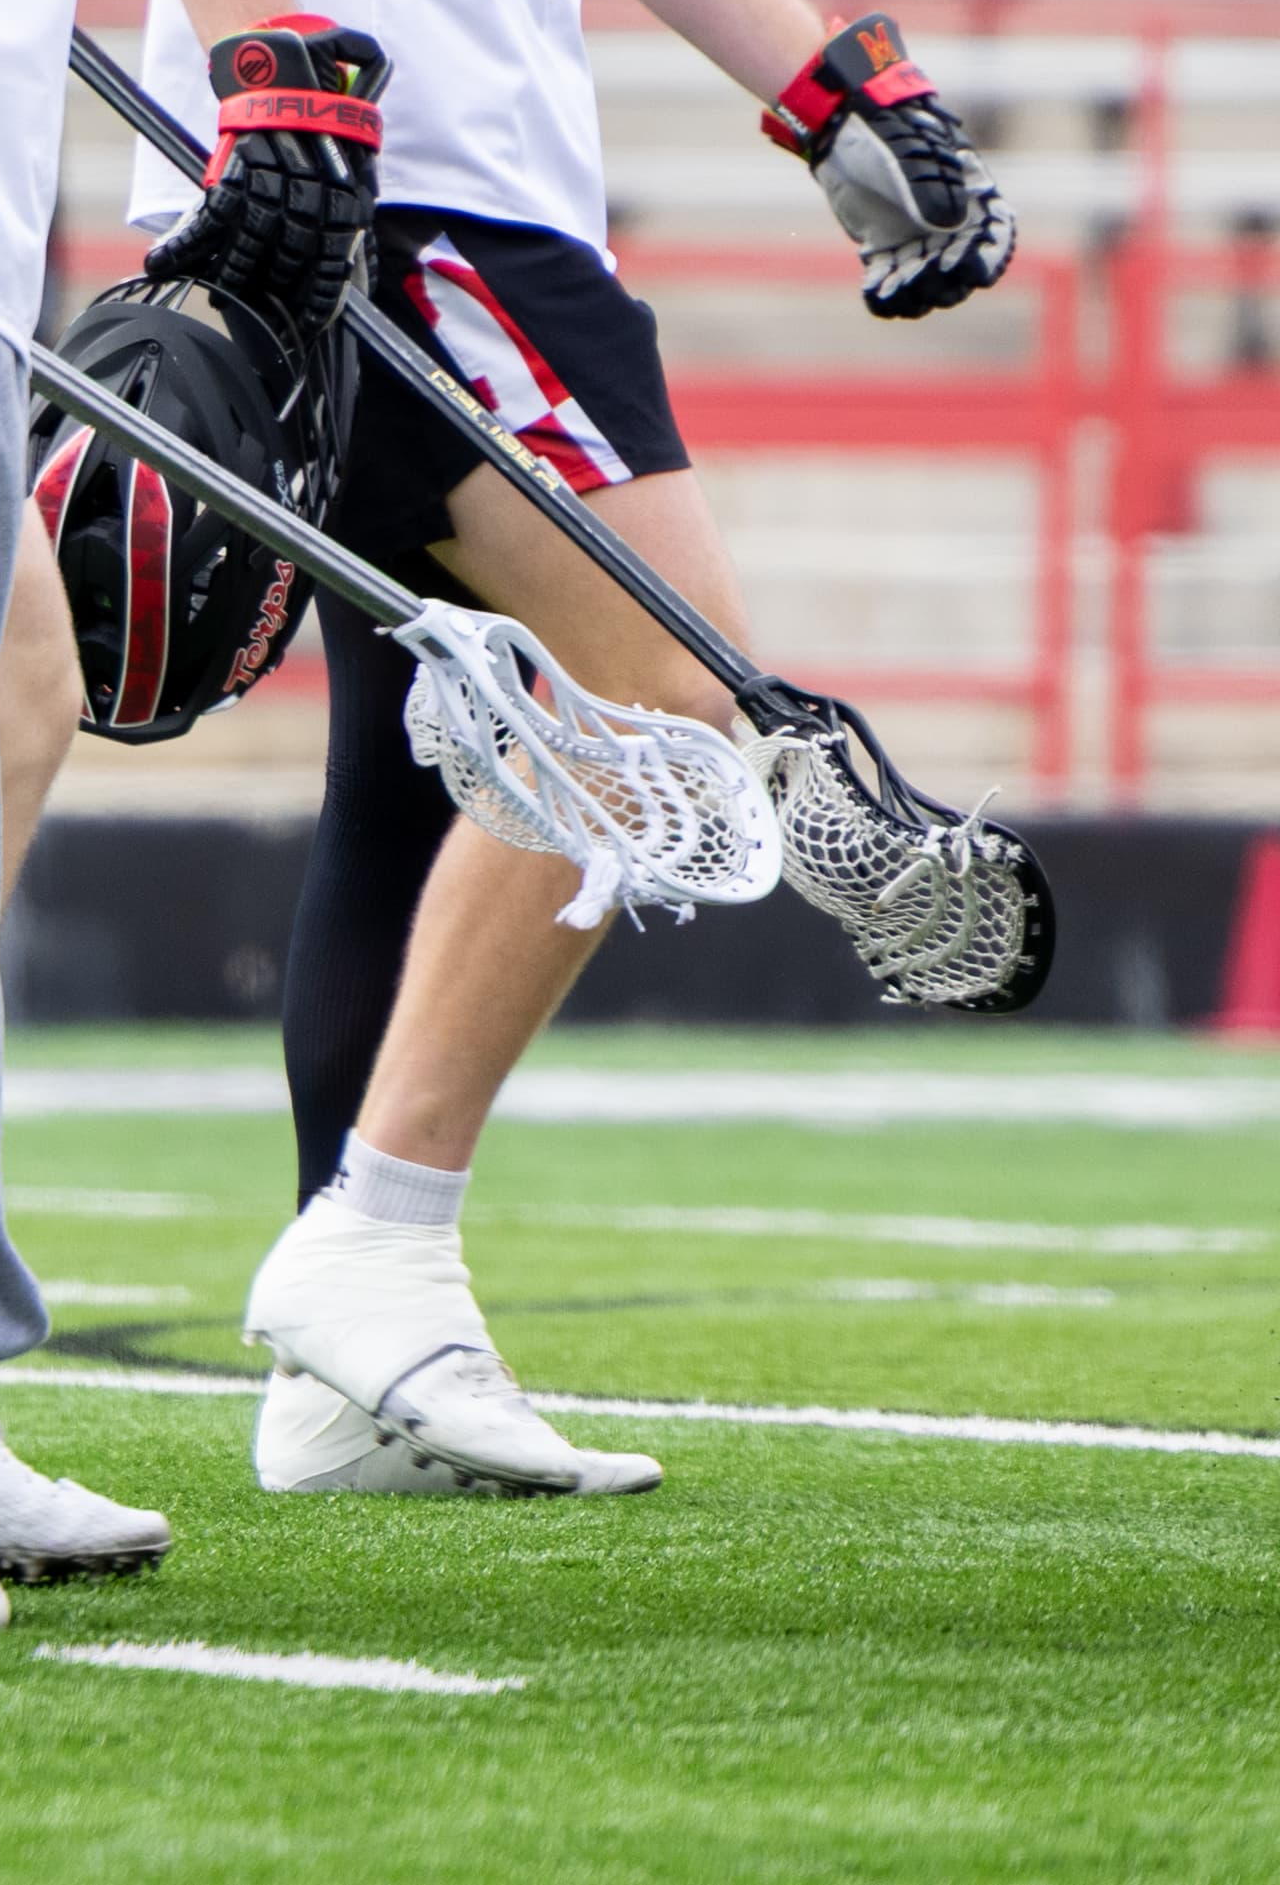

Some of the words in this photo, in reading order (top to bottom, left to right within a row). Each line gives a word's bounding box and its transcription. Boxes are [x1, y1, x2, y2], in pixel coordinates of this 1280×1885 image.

[856, 21, 901, 72] M
[246, 95, 383, 135] MAVER
[223, 558, 295, 693] Terps
